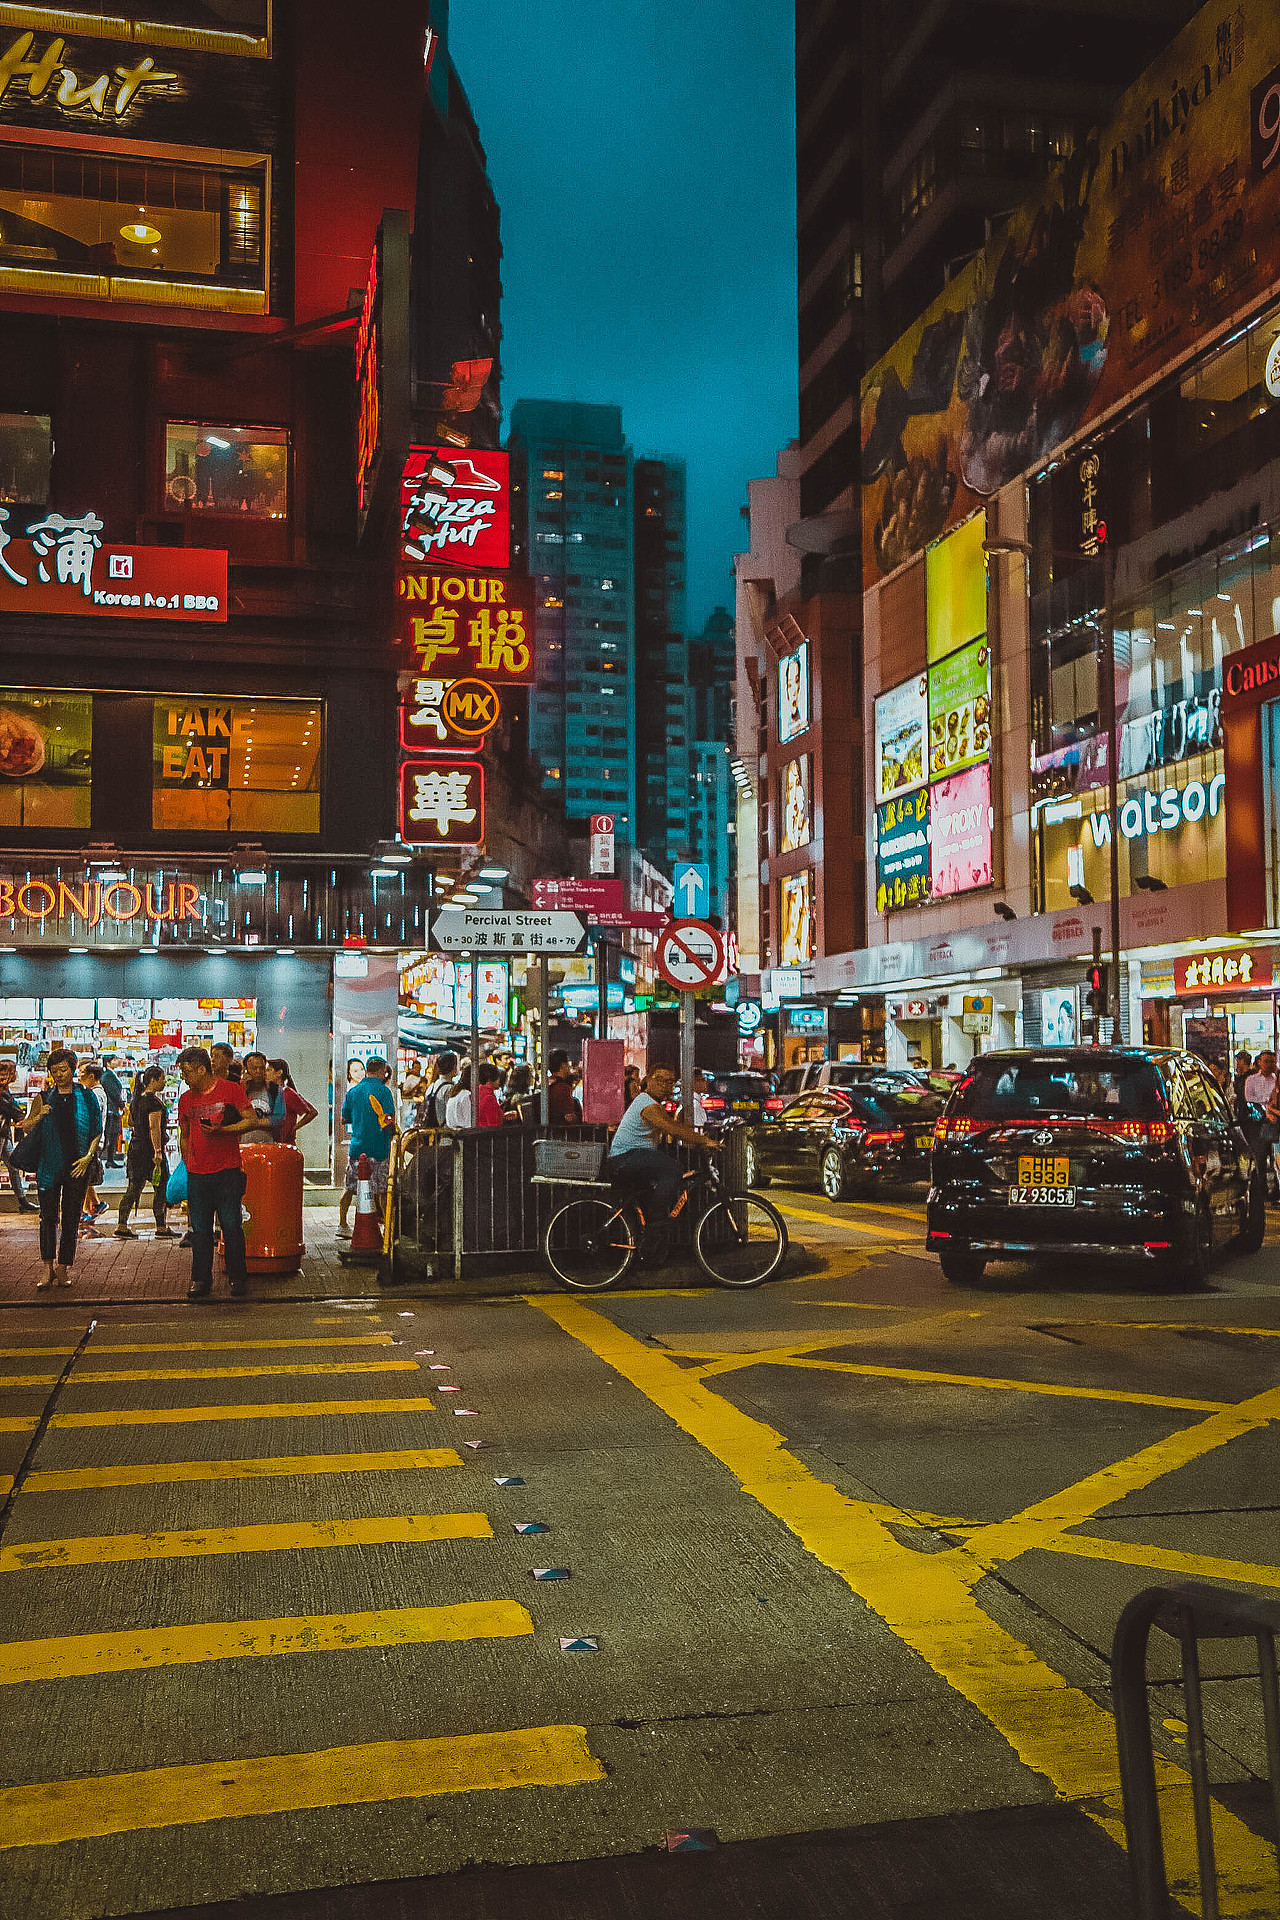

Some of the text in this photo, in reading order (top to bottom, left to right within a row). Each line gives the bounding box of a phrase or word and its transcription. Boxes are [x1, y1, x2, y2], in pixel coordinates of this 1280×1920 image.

[93, 591, 141, 606] Korea
[183, 595, 219, 611] BBQ
[449, 692, 493, 721] MX
[162, 707, 252, 737] TAKE
[163, 745, 228, 779] EAT
[465, 914, 552, 926] Percival Street
[474, 932, 543, 946] 波斯富街
[1033, 1157, 1055, 1171] HH
[1021, 1171, 1067, 1185] 3933
